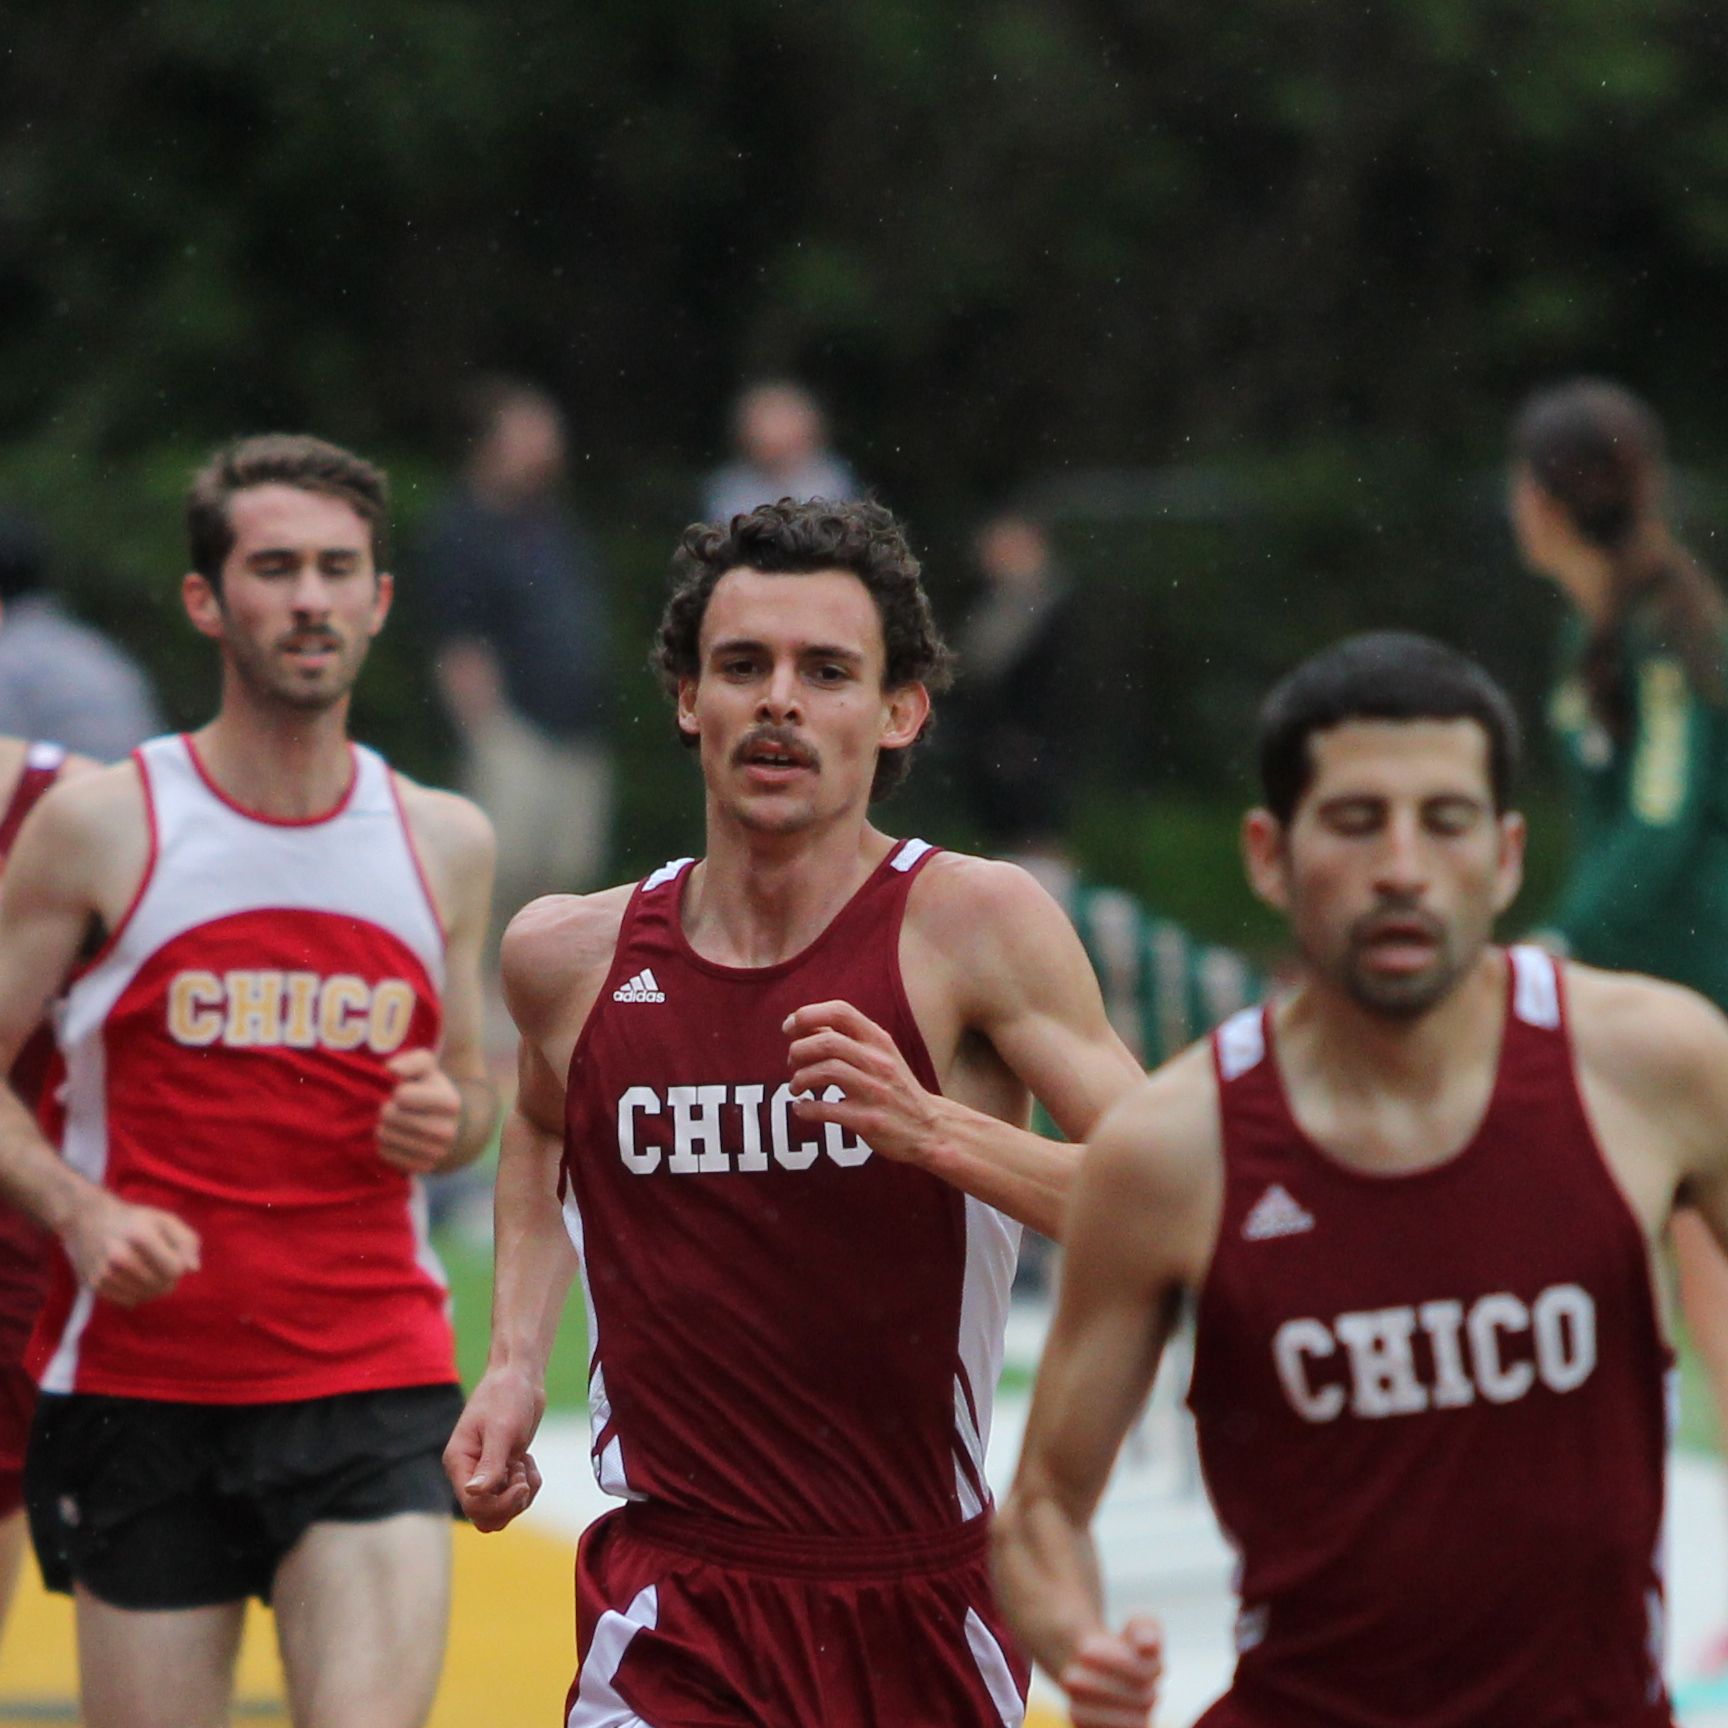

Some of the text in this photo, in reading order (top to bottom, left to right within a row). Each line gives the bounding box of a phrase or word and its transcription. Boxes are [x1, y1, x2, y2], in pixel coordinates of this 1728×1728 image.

[167, 969, 417, 1054] CHICO
[613, 990, 666, 1003] adidas
[1273, 1283, 1598, 1423] CHICO
